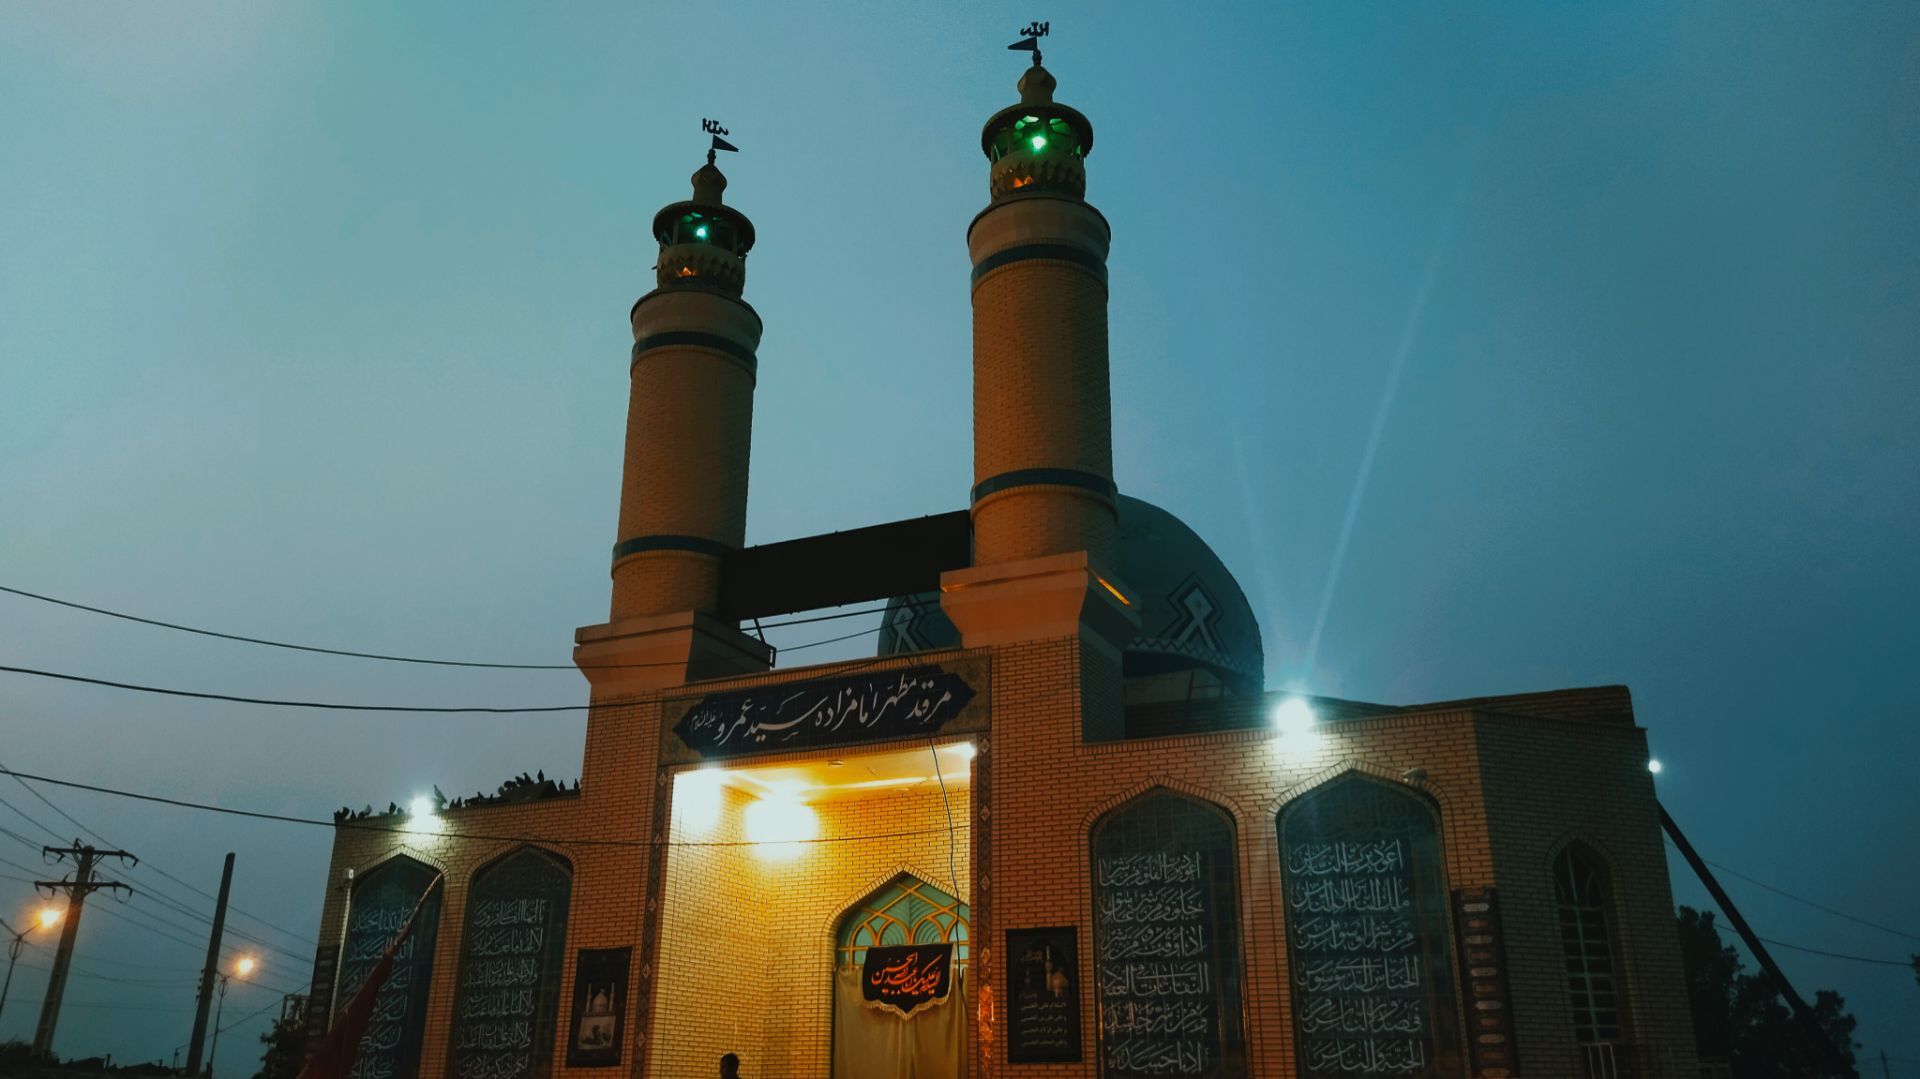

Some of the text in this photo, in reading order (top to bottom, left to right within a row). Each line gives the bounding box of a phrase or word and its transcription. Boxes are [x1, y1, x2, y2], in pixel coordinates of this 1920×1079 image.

[713, 698, 754, 746] عمرو
[866, 673, 917, 729] مطهر
[905, 680, 952, 723] مرقد
